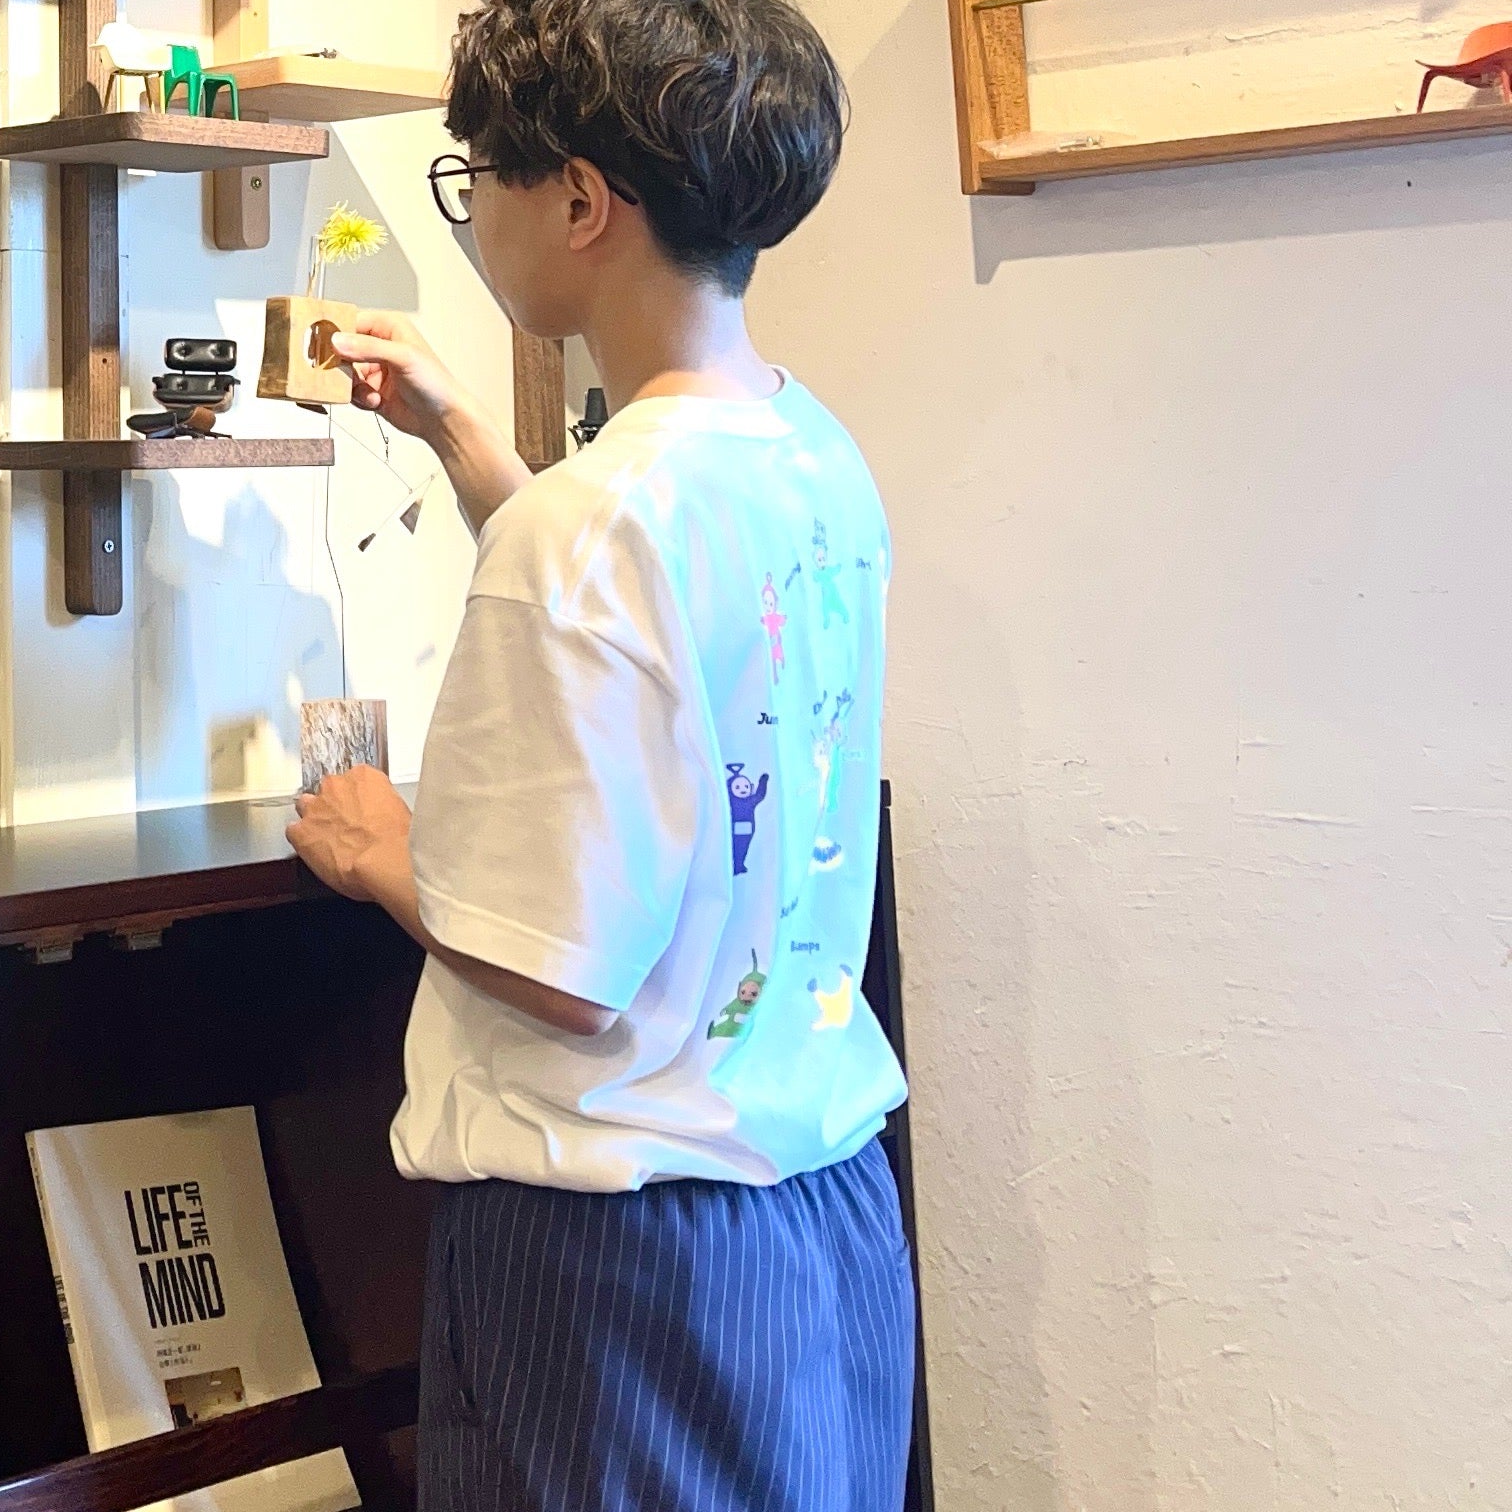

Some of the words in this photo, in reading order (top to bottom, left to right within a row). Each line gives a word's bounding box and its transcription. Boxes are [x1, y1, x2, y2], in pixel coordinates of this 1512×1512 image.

[124, 1184, 193, 1256] LIFE
[184, 1181, 202, 1206] OF
[189, 1208, 210, 1247] THE
[139, 1253, 226, 1329] MIND
